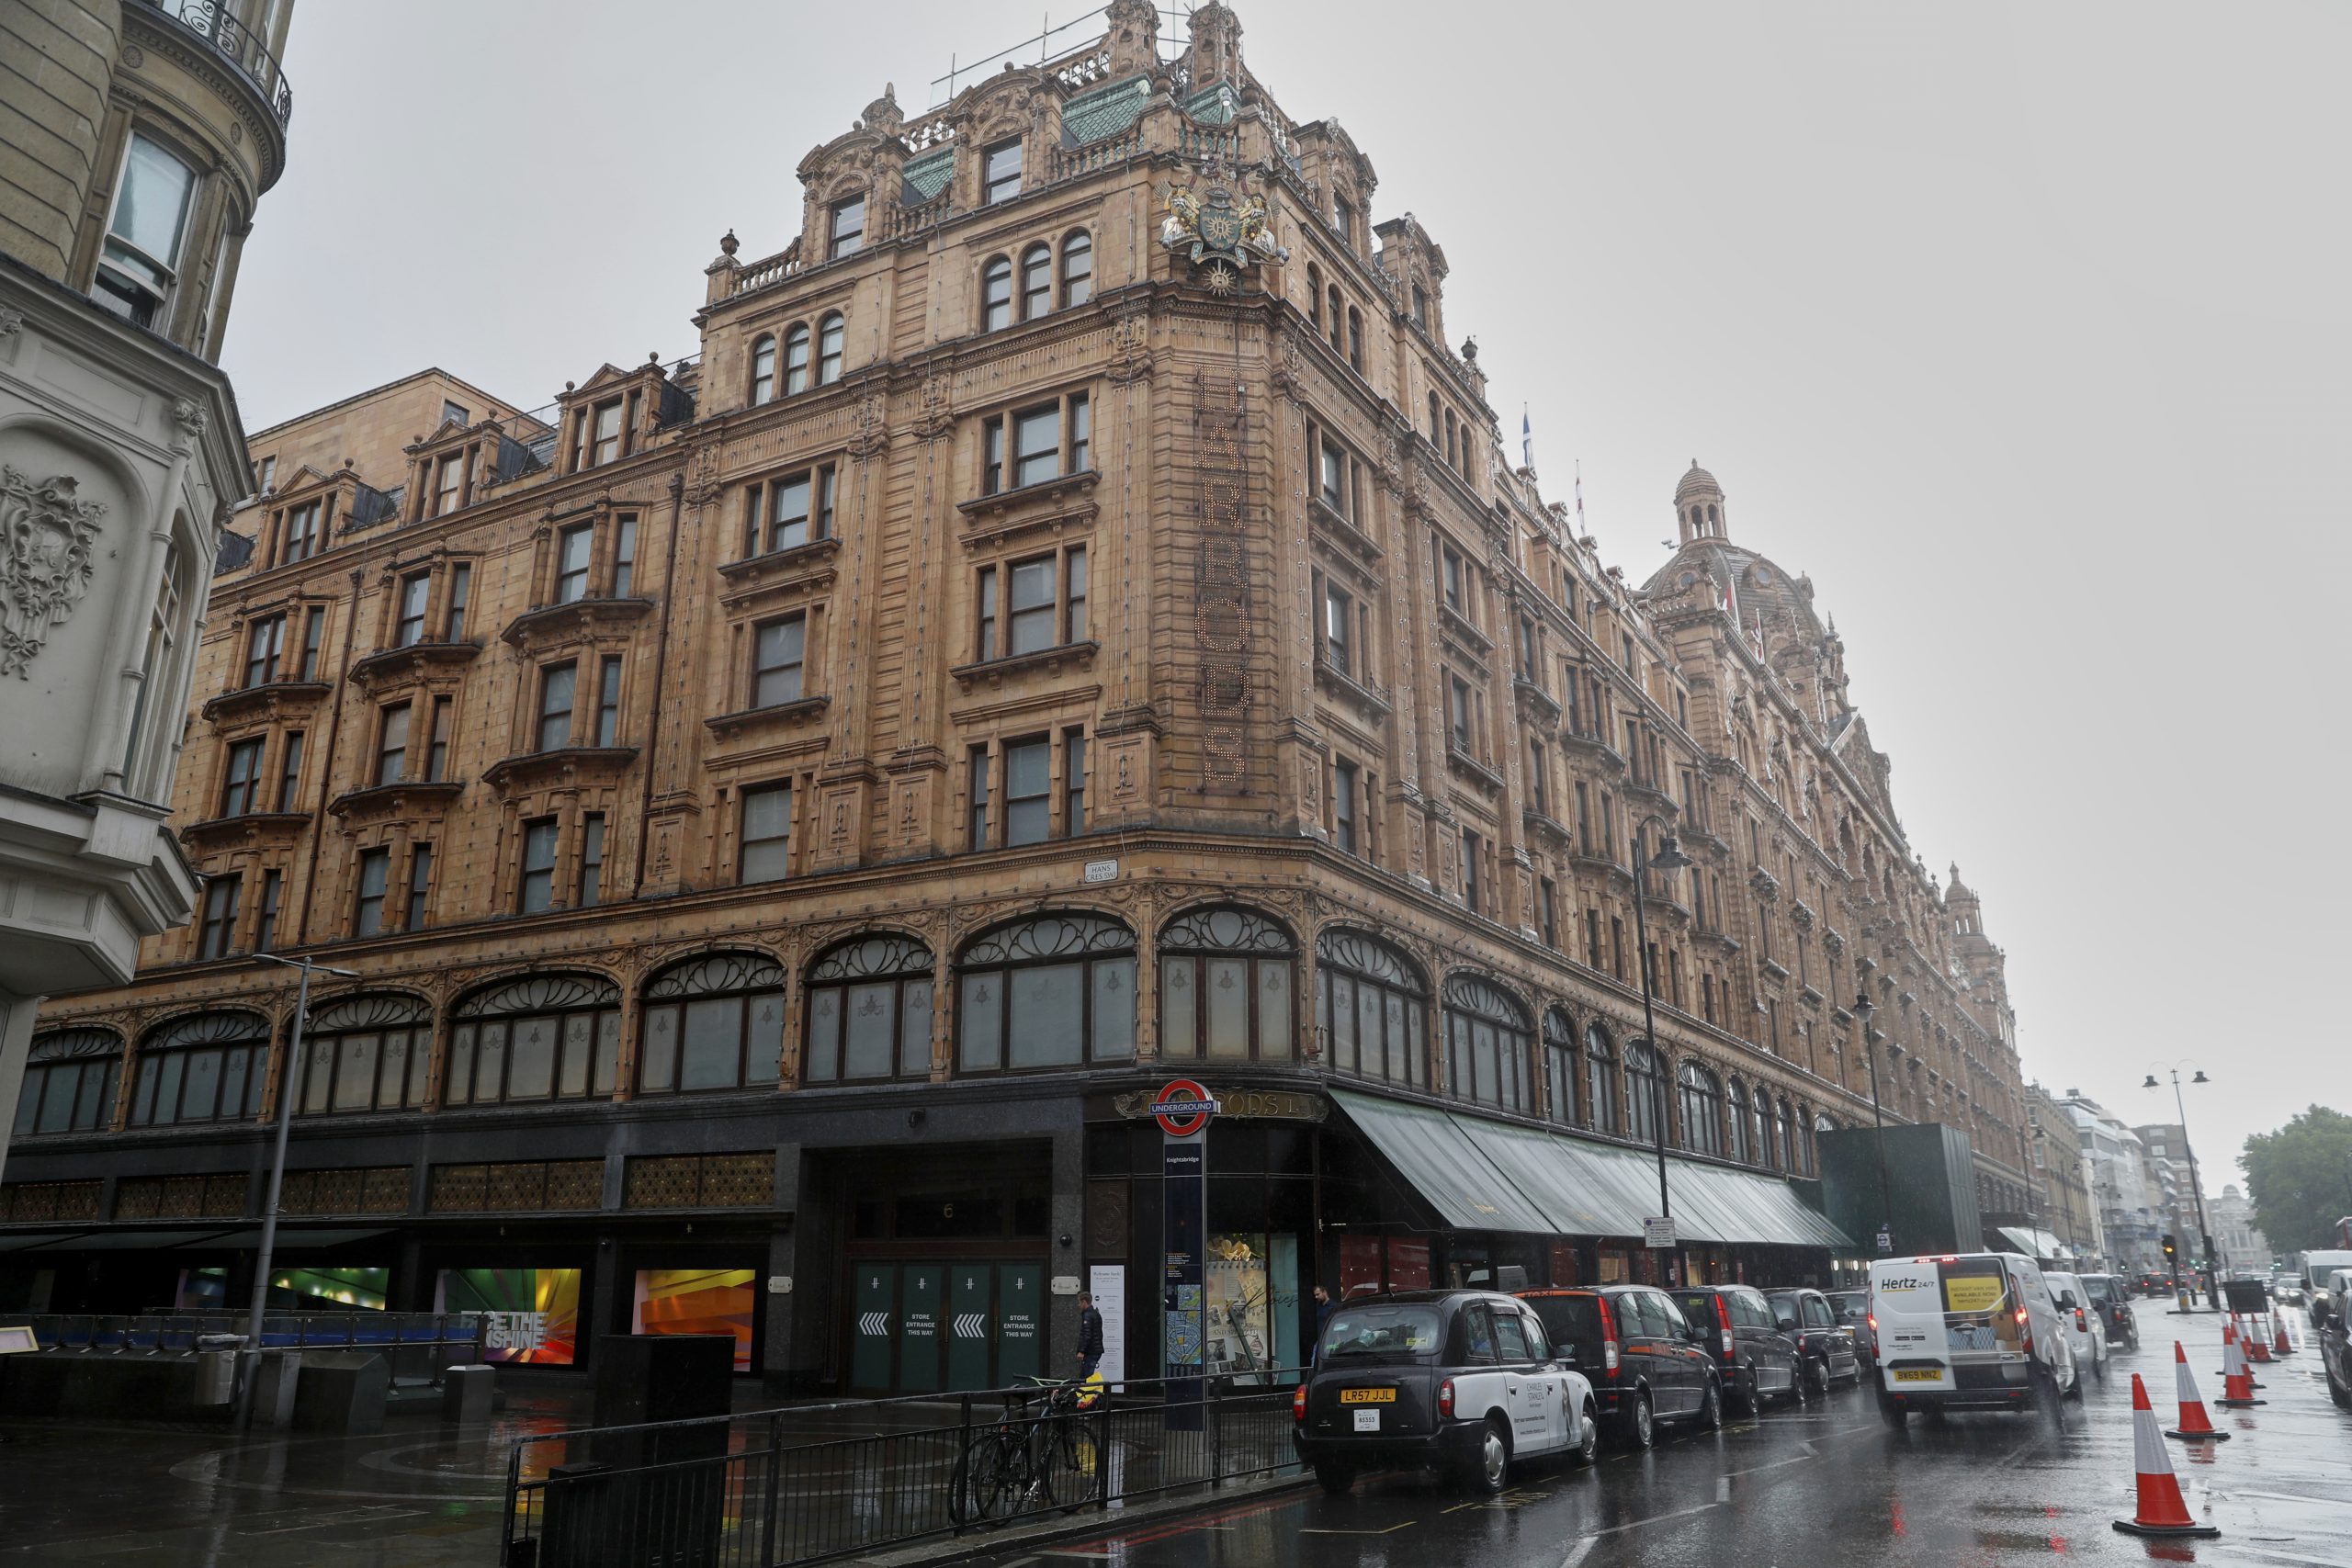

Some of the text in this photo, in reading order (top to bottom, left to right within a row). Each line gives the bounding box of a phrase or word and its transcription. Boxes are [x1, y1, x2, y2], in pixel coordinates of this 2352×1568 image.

[1193, 364, 1253, 782] HARRODS
[1091, 864, 1111, 874] HANS
[1151, 1102, 1212, 1112] UNDERGROUND
[1166, 1156, 1200, 1164] Knightsbridge
[943, 1202, 954, 1219] 6
[1882, 1277, 1917, 1290] Hertz
[509, 1312, 548, 1332] THE
[1345, 1390, 1391, 1401] LR57 JJL
